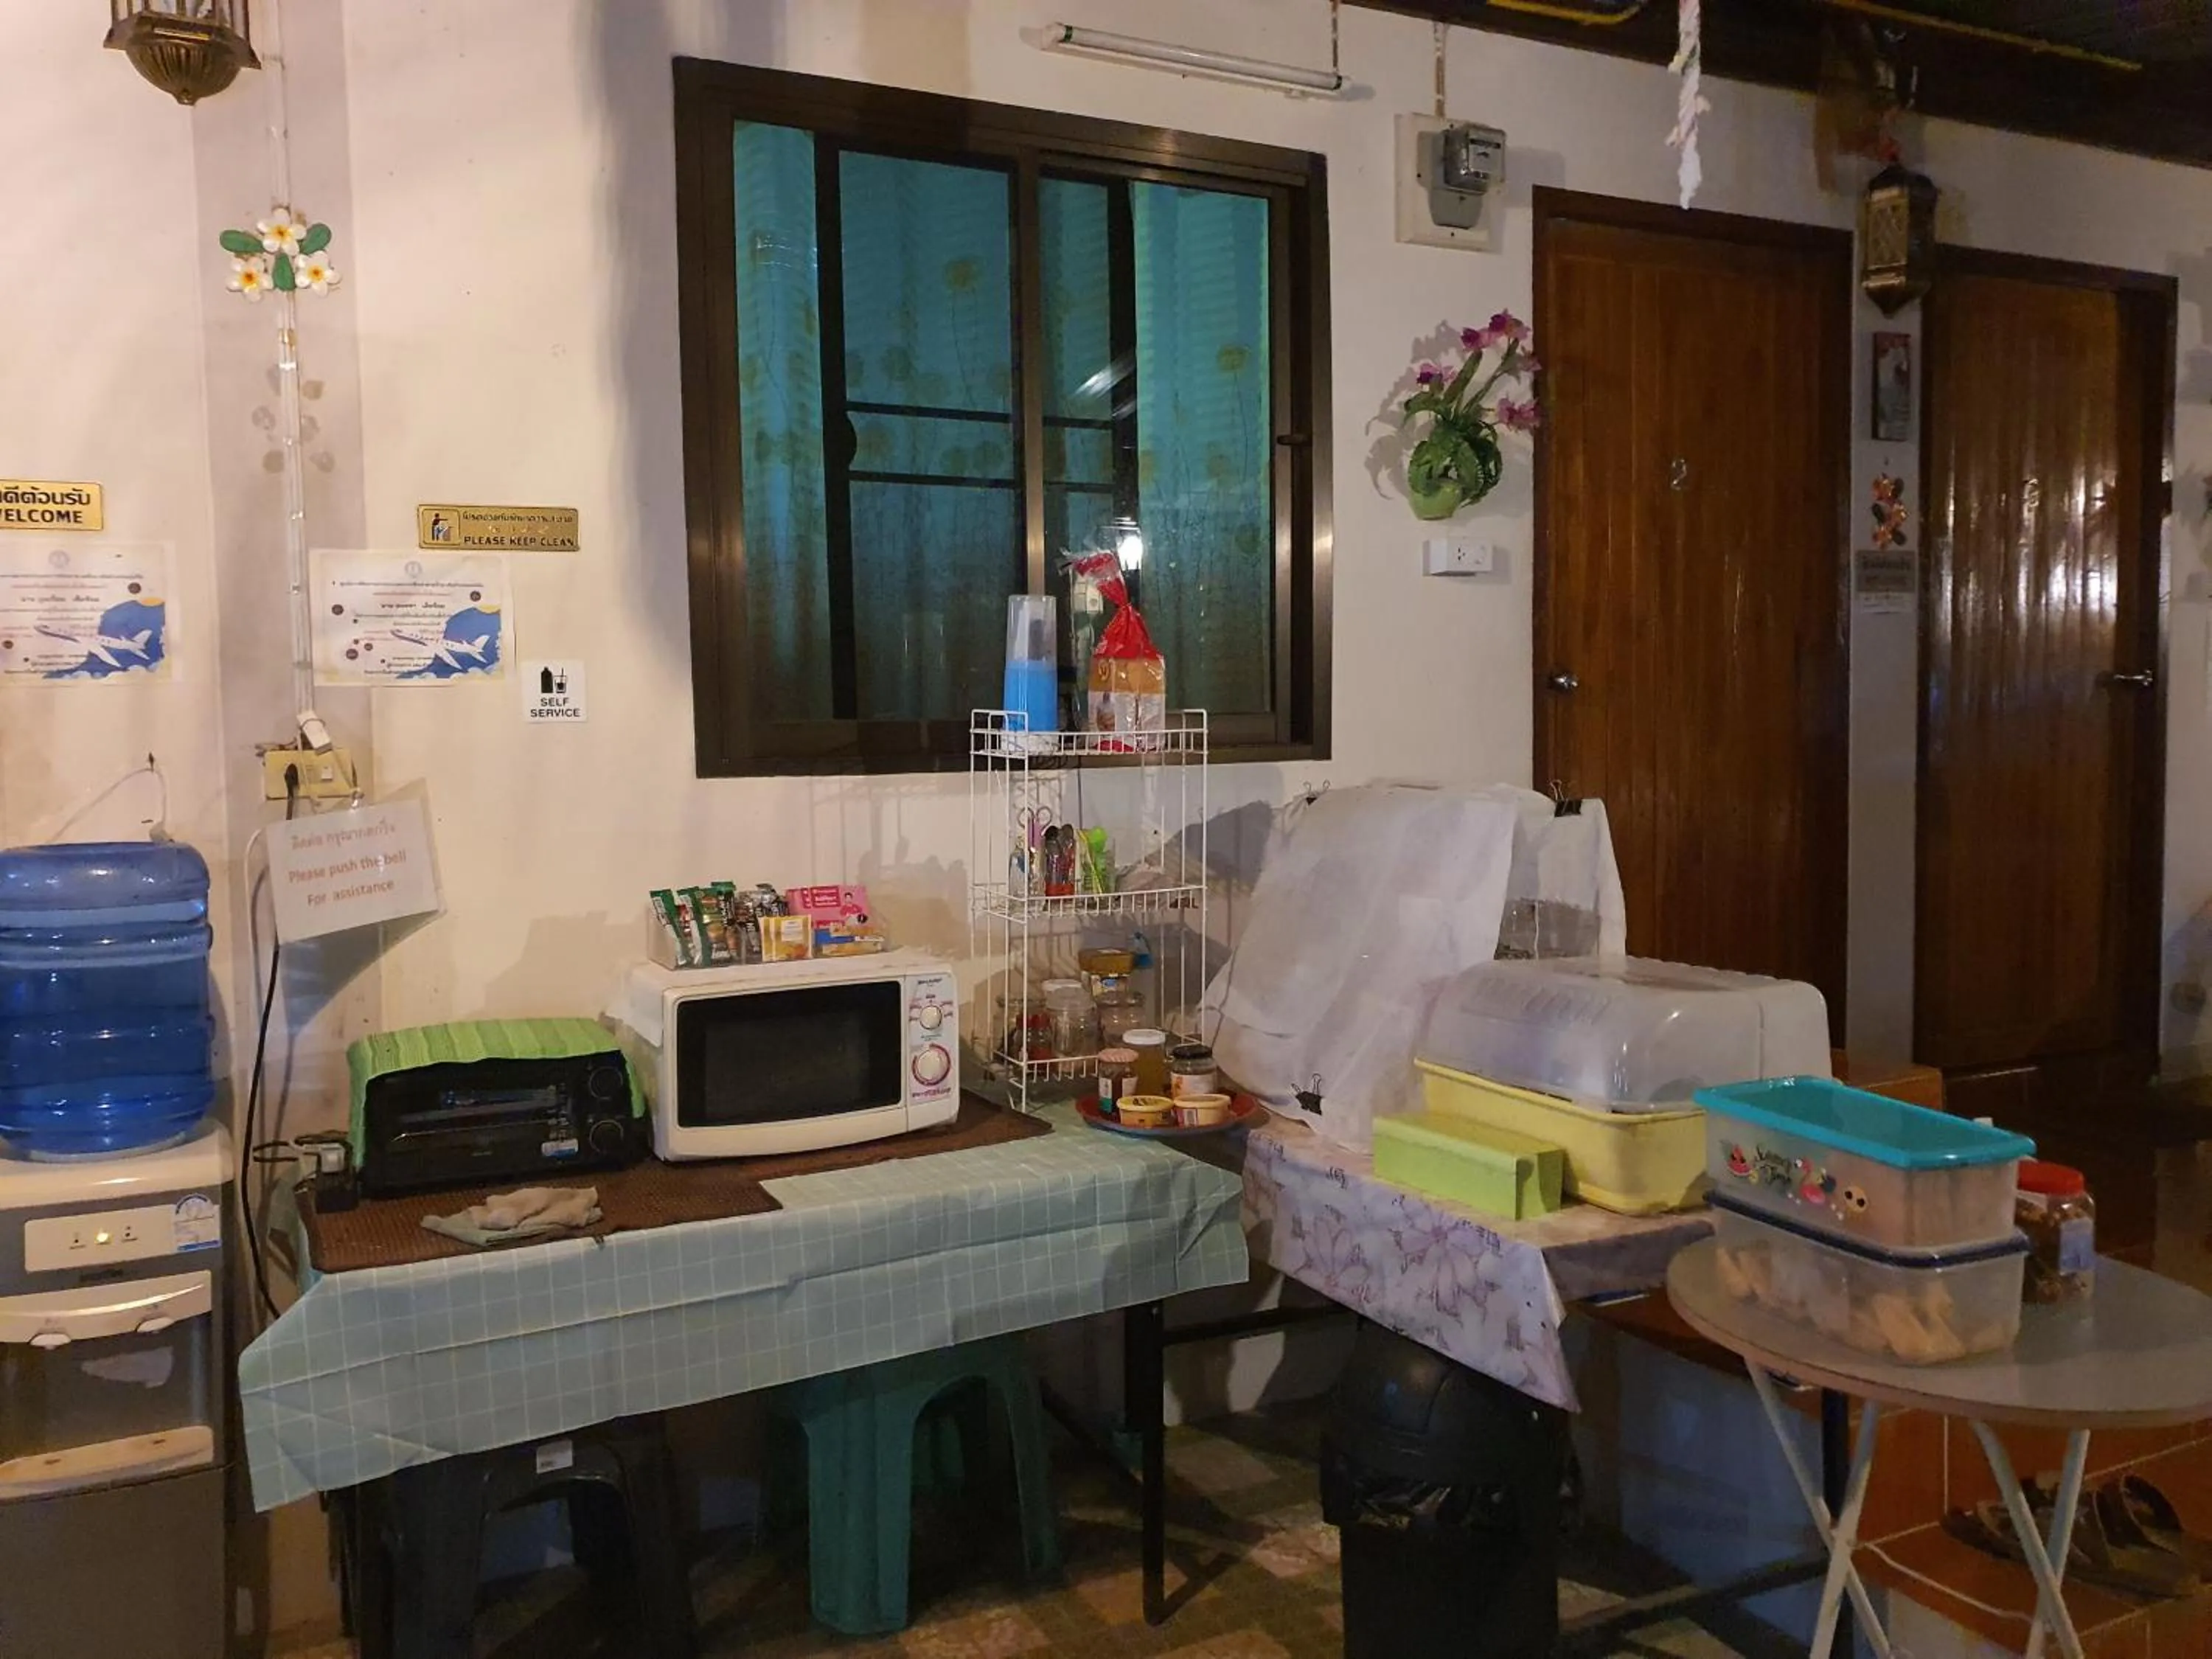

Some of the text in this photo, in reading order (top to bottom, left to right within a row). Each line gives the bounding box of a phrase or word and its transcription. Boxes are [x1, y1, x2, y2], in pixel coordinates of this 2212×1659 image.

[0, 508, 83, 524] ELCOME
[464, 536, 574, 546] PLEASE KEEP CLEAN
[540, 697, 569, 706] SELF
[530, 708, 580, 717] SERVICE
[289, 849, 407, 883] Please push the bell
[307, 880, 394, 906] For assistance
